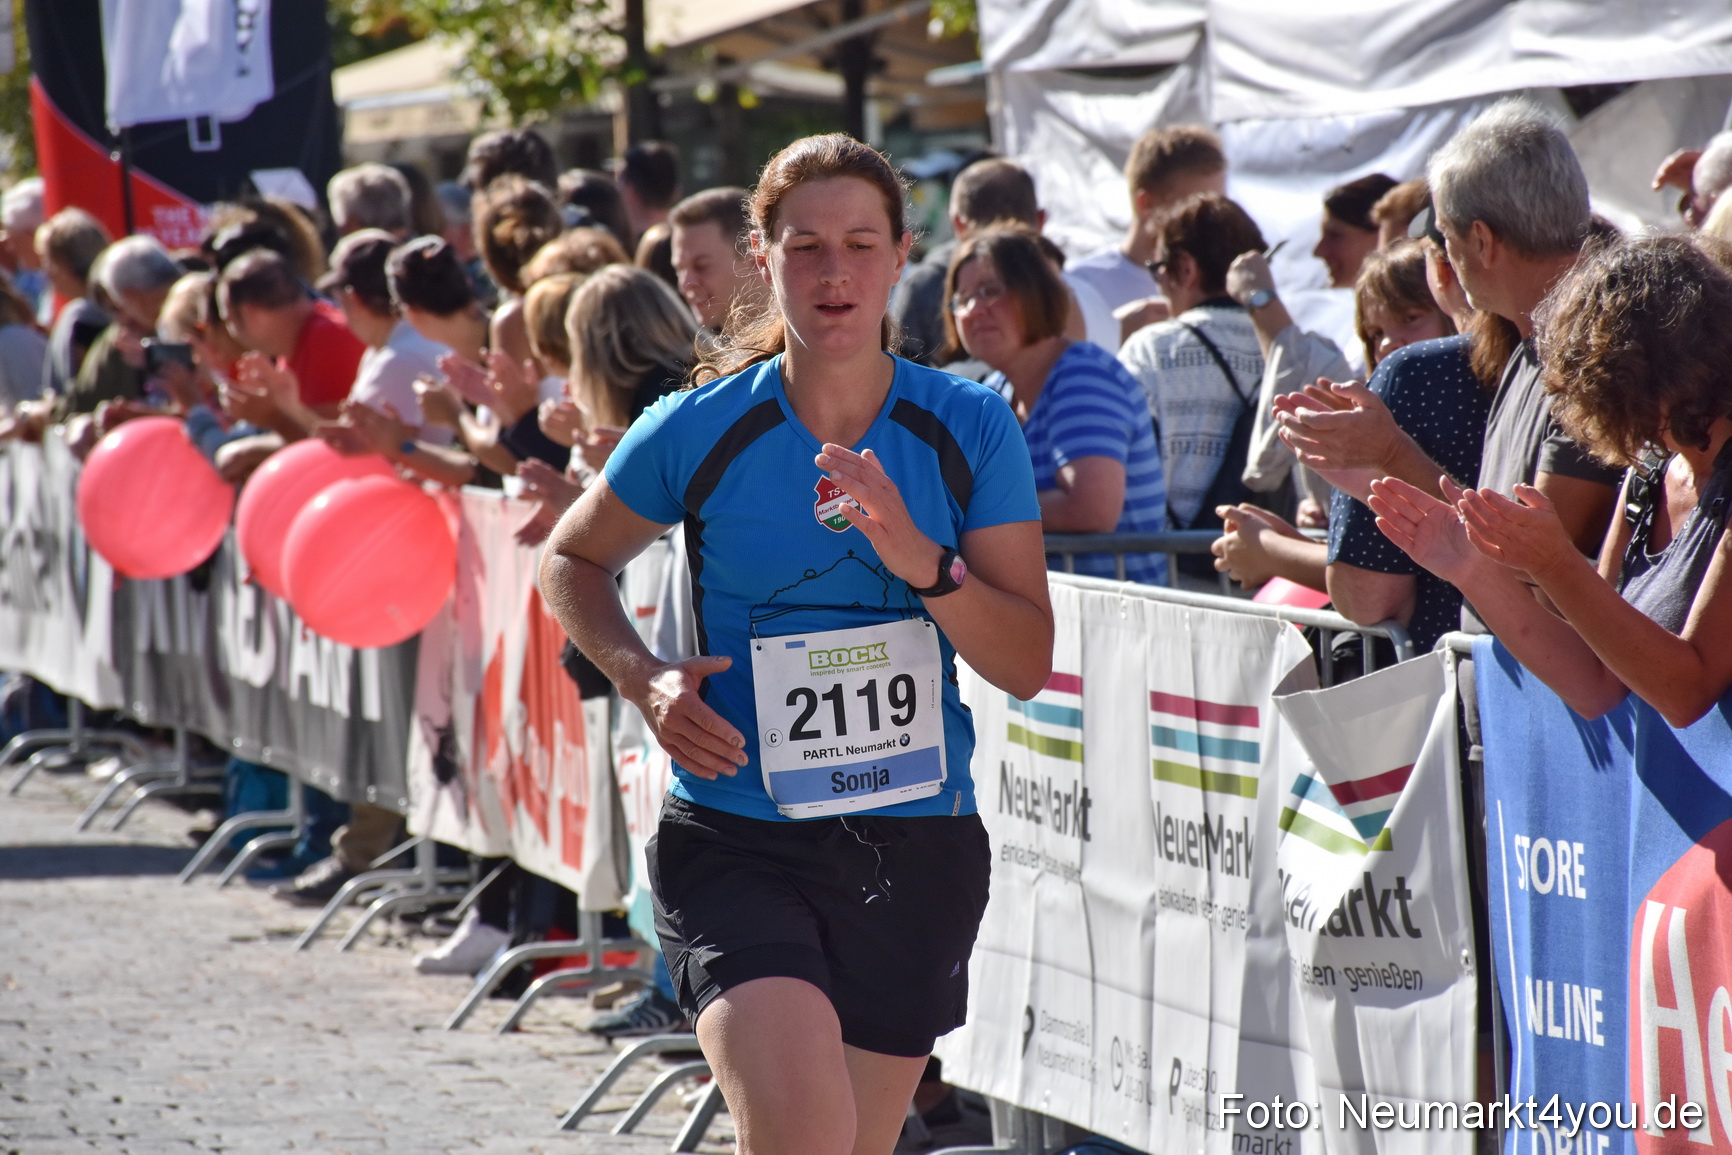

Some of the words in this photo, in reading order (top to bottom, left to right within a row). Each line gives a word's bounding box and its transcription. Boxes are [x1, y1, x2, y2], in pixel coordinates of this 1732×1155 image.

[808, 641, 889, 670] BOCK
[810, 668, 836, 677] inspired
[836, 667, 845, 676] by
[846, 665, 865, 674] smart
[866, 661, 891, 672] concepts
[785, 673, 917, 741] 2119
[803, 747, 843, 761] PARTL
[846, 738, 897, 756] Neumarkt
[831, 766, 890, 794] Sonja
[1514, 833, 1587, 900] STORE
[1344, 961, 1423, 993] genießen
[1524, 975, 1605, 1047] NLINE
